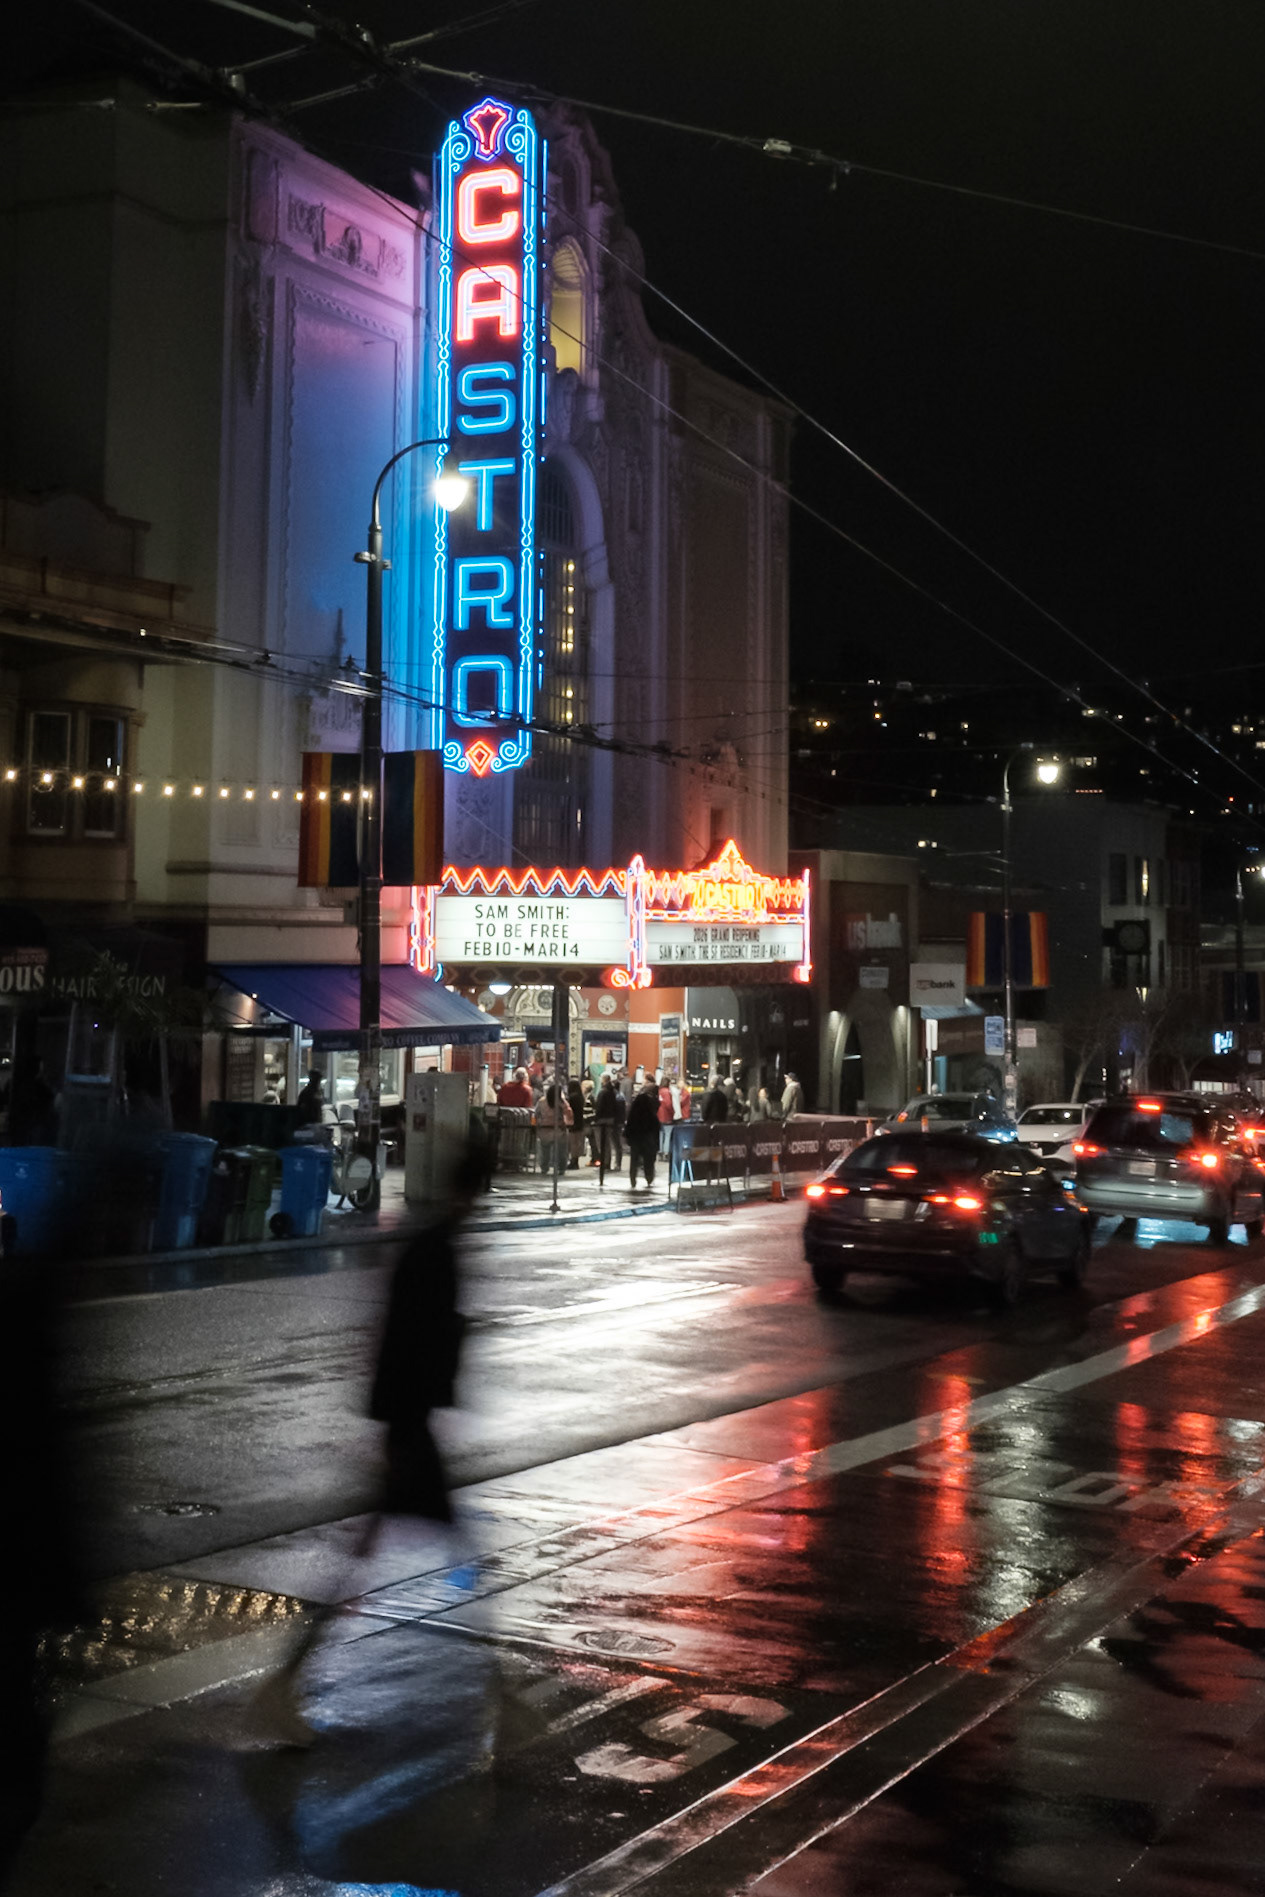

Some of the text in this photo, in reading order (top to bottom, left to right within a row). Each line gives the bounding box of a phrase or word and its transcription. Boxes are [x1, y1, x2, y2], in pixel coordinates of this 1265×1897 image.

[453, 167, 521, 728] CASTRO
[705, 883, 755, 908] CASTRO
[475, 904, 570, 920] SAM SMITH:
[476, 923, 569, 939] TO BE FREE
[51, 975, 167, 999] HAIR ESIGN
[691, 1017, 736, 1030] NAILS
[791, 1140, 820, 1155] CASTRO
